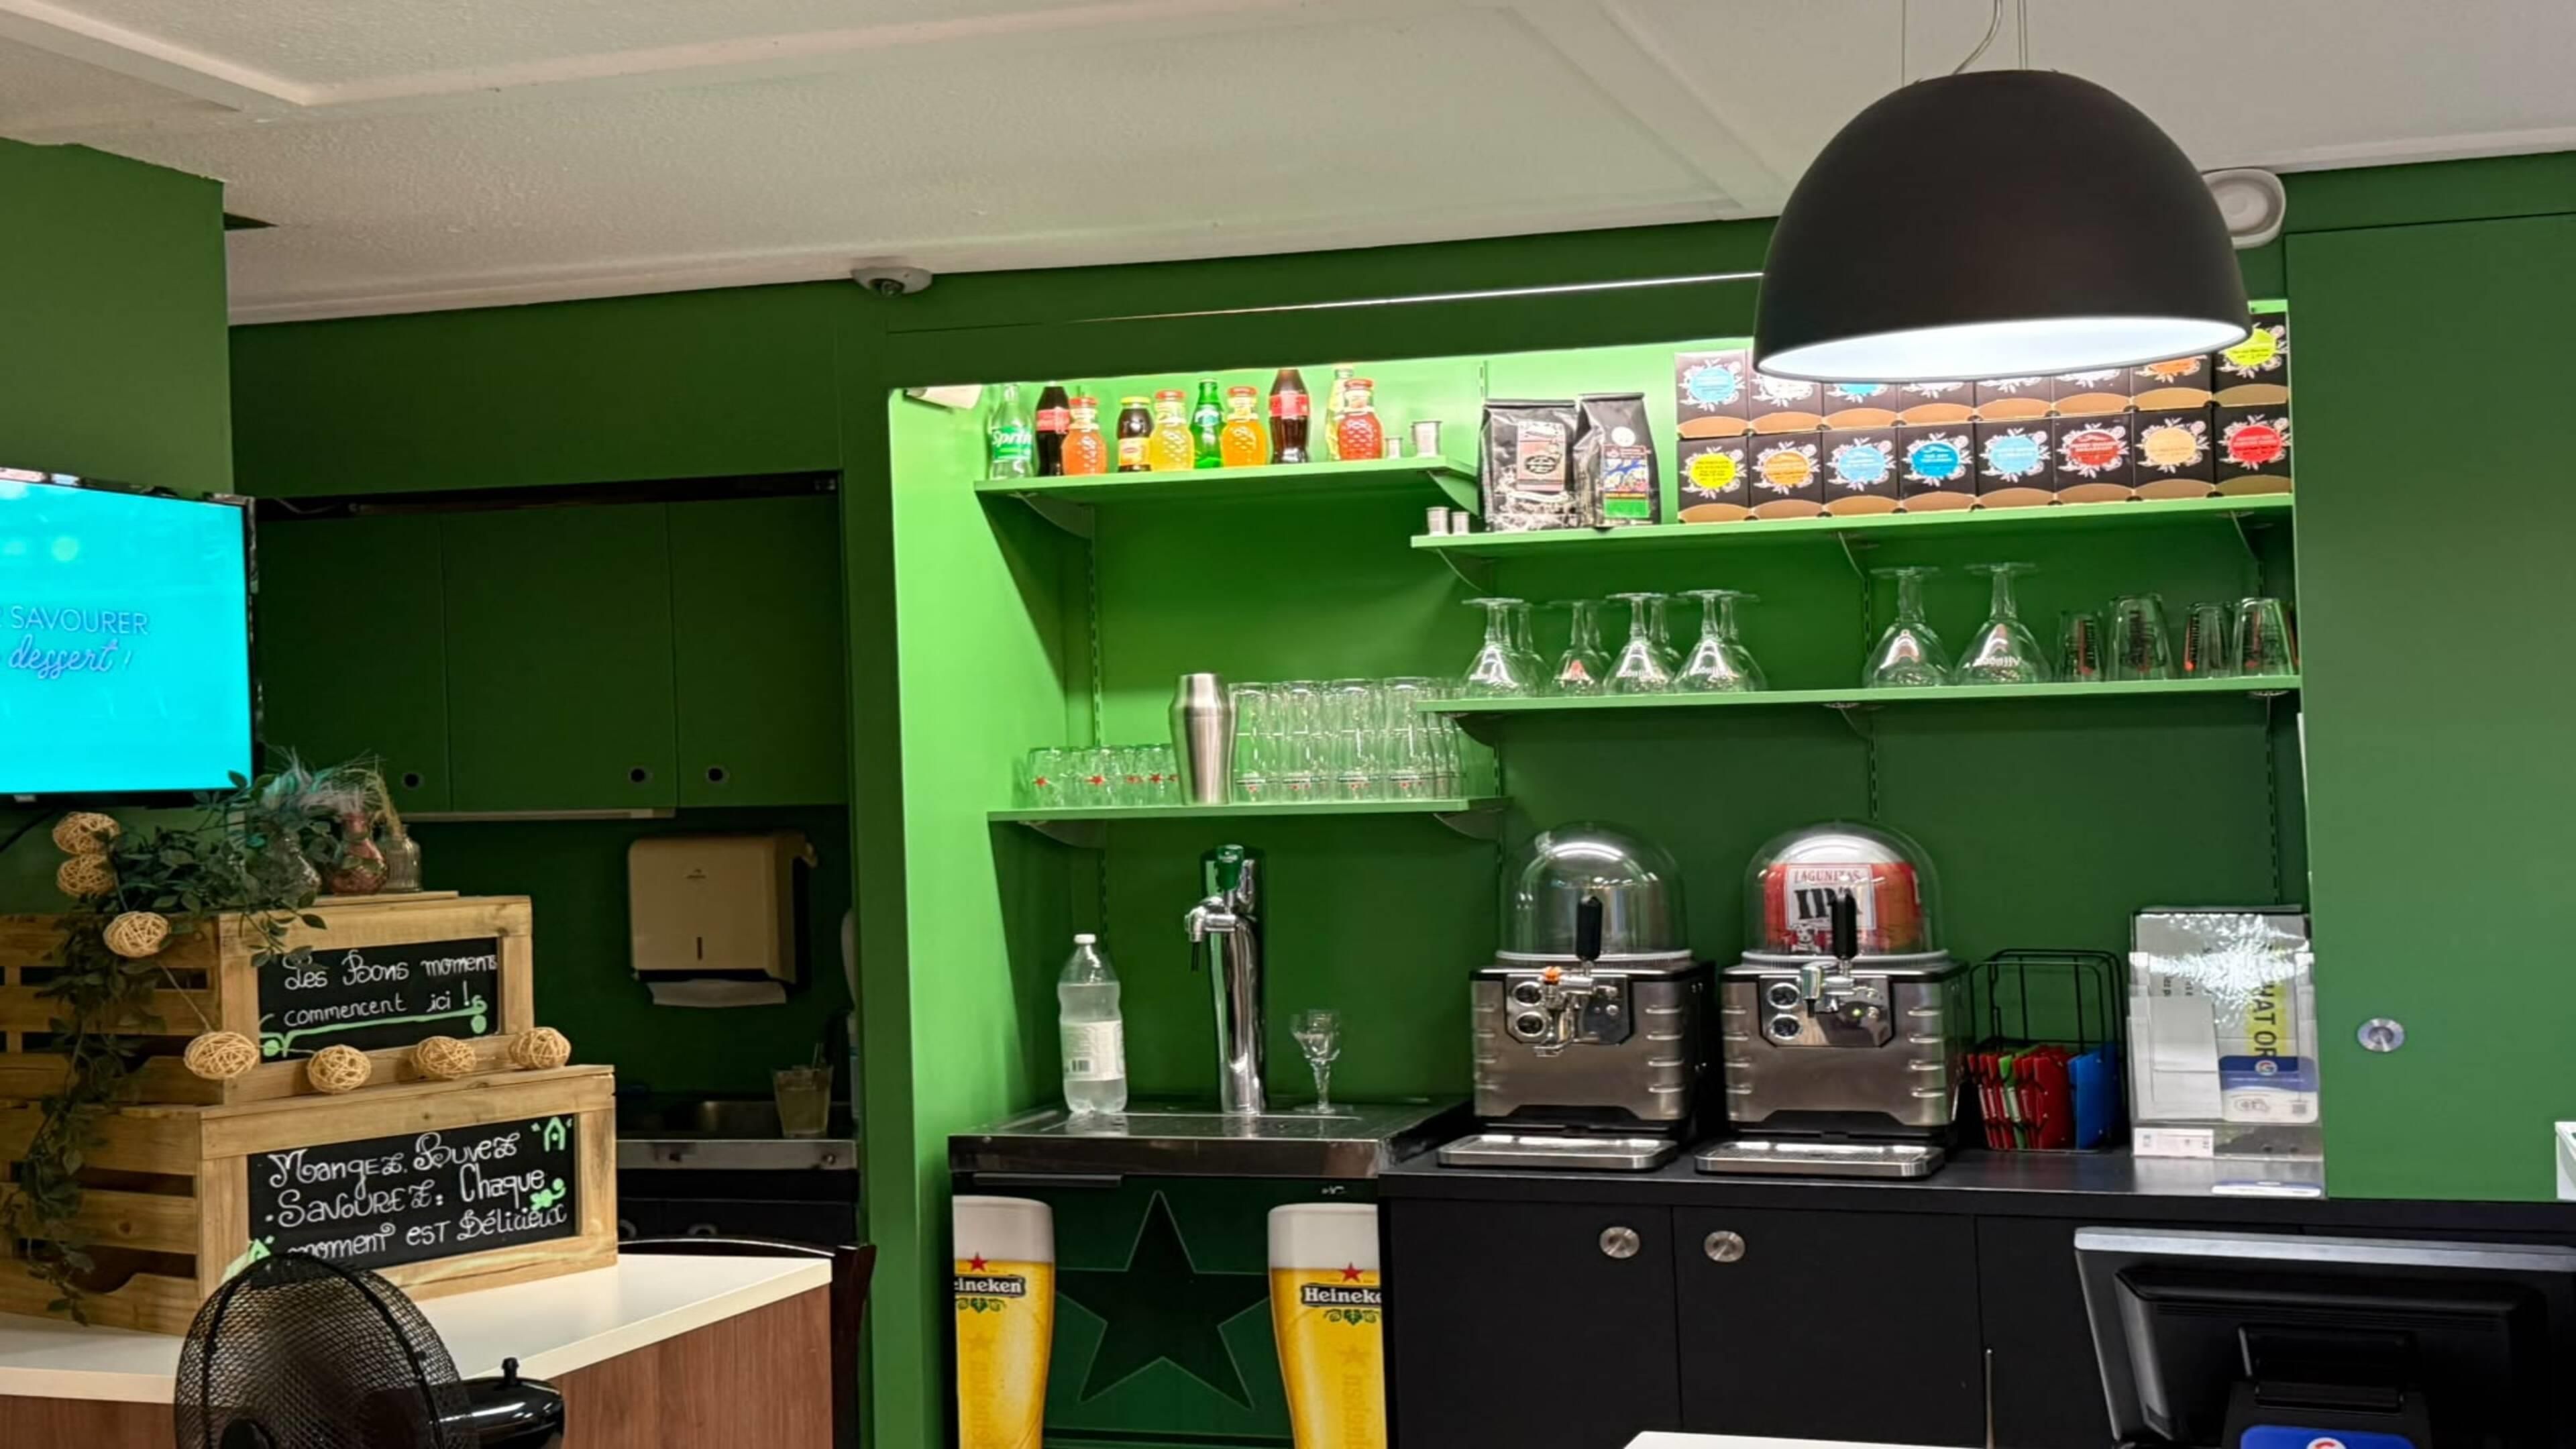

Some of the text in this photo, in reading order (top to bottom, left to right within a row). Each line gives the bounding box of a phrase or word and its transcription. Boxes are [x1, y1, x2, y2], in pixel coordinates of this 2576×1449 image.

[11, 605, 148, 635] SAVOURER
[9, 633, 117, 679] dessert
[1794, 887, 1863, 919] IP
[341, 949, 409, 985] Bons
[284, 992, 407, 1027] commencent
[426, 990, 451, 1013] ici
[460, 1163, 545, 1208] Chaque
[953, 1277, 1022, 1293] eineken
[1303, 1287, 1381, 1303] Heineke
